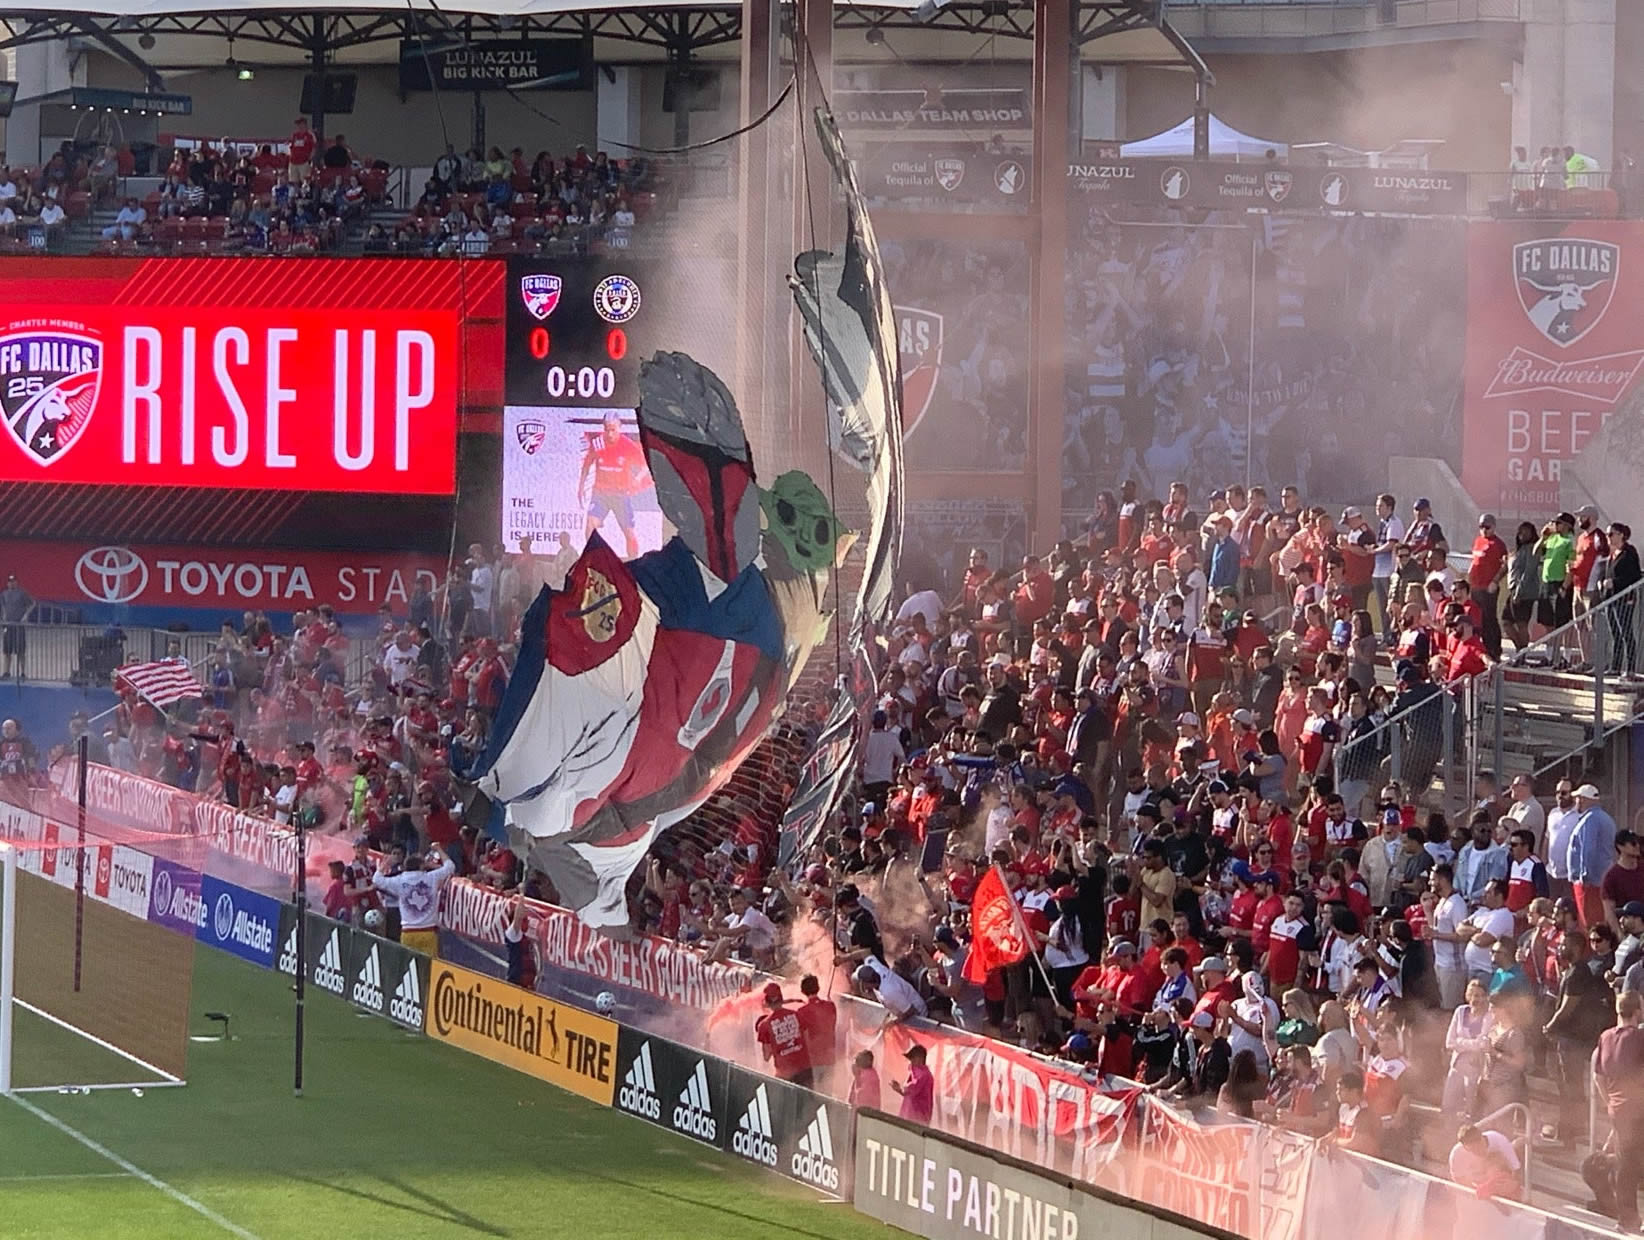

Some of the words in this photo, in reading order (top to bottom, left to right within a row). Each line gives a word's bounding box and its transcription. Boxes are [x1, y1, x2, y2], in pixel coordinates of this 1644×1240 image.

[443, 66, 468, 79] BIG
[508, 66, 539, 78] BAR
[847, 111, 915, 122] DALLAS
[920, 110, 969, 122] TEAM
[972, 109, 1023, 122] SHOP
[892, 162, 927, 173] Official
[1224, 174, 1258, 185] Official
[1373, 176, 1453, 190] LUNAZUL
[1521, 246, 1542, 273] FC
[1549, 245, 1611, 273] DALLAS
[0, 343, 22, 375] FC
[28, 341, 94, 375] DALLAS
[529, 327, 550, 360] 0
[606, 327, 627, 361] 0
[8, 376, 45, 399] 25
[546, 365, 616, 399] 0:00
[1498, 358, 1632, 386] Budweiser
[122, 326, 298, 468] RISE
[333, 328, 436, 472] UP
[1508, 409, 1612, 454] BEE
[1508, 458, 1562, 481] GAR
[511, 498, 534, 508] THE
[509, 511, 545, 529] LEGACY
[549, 512, 585, 530] JERSEY
[510, 531, 521, 541] IS
[526, 532, 559, 542] HERE
[156, 560, 315, 600] TOYOTA
[114, 863, 147, 898] TOYOTA
[168, 886, 208, 929] Allstate
[230, 909, 273, 954] Allstate
[314, 966, 345, 994] adidas
[608, 938, 655, 993] BEER
[353, 982, 384, 1011] adidas
[390, 998, 423, 1027] adidas
[434, 969, 543, 1058] Continental
[564, 1028, 611, 1084] TIRE
[619, 1083, 661, 1120] adidas
[673, 1103, 717, 1141] adidas
[732, 1127, 778, 1167] adidas
[791, 1152, 839, 1190] adidas
[865, 1138, 937, 1215] TITLE
